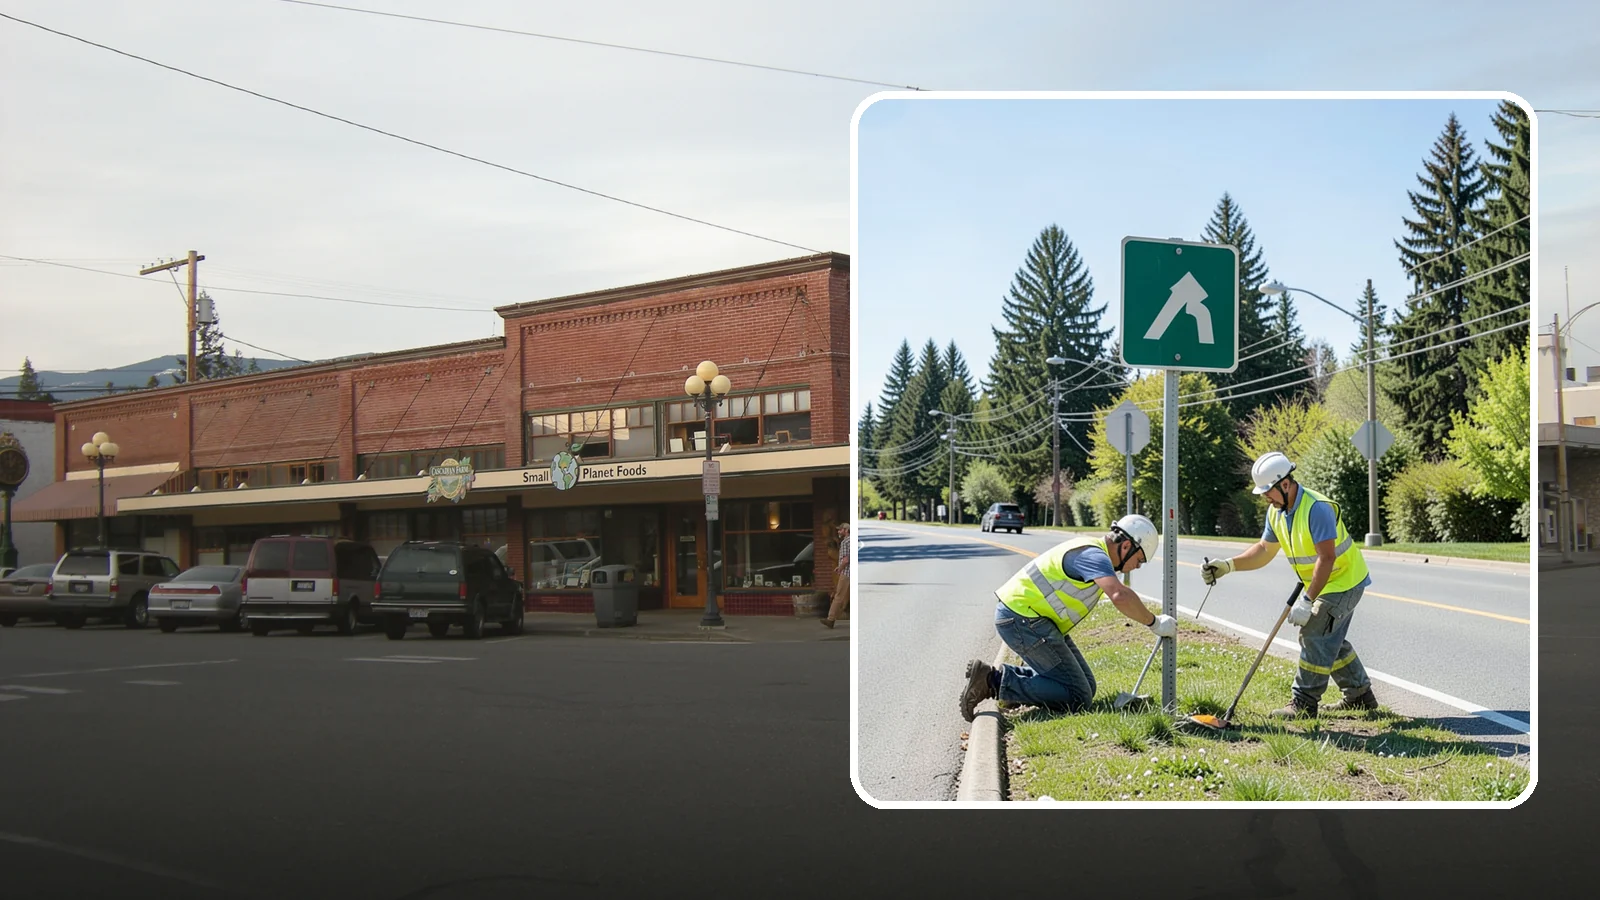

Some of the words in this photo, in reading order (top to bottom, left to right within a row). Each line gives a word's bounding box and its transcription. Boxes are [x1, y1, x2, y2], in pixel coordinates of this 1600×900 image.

[523, 471, 549, 483] Small
[583, 467, 614, 479] Planet
[617, 464, 647, 477] Foods
